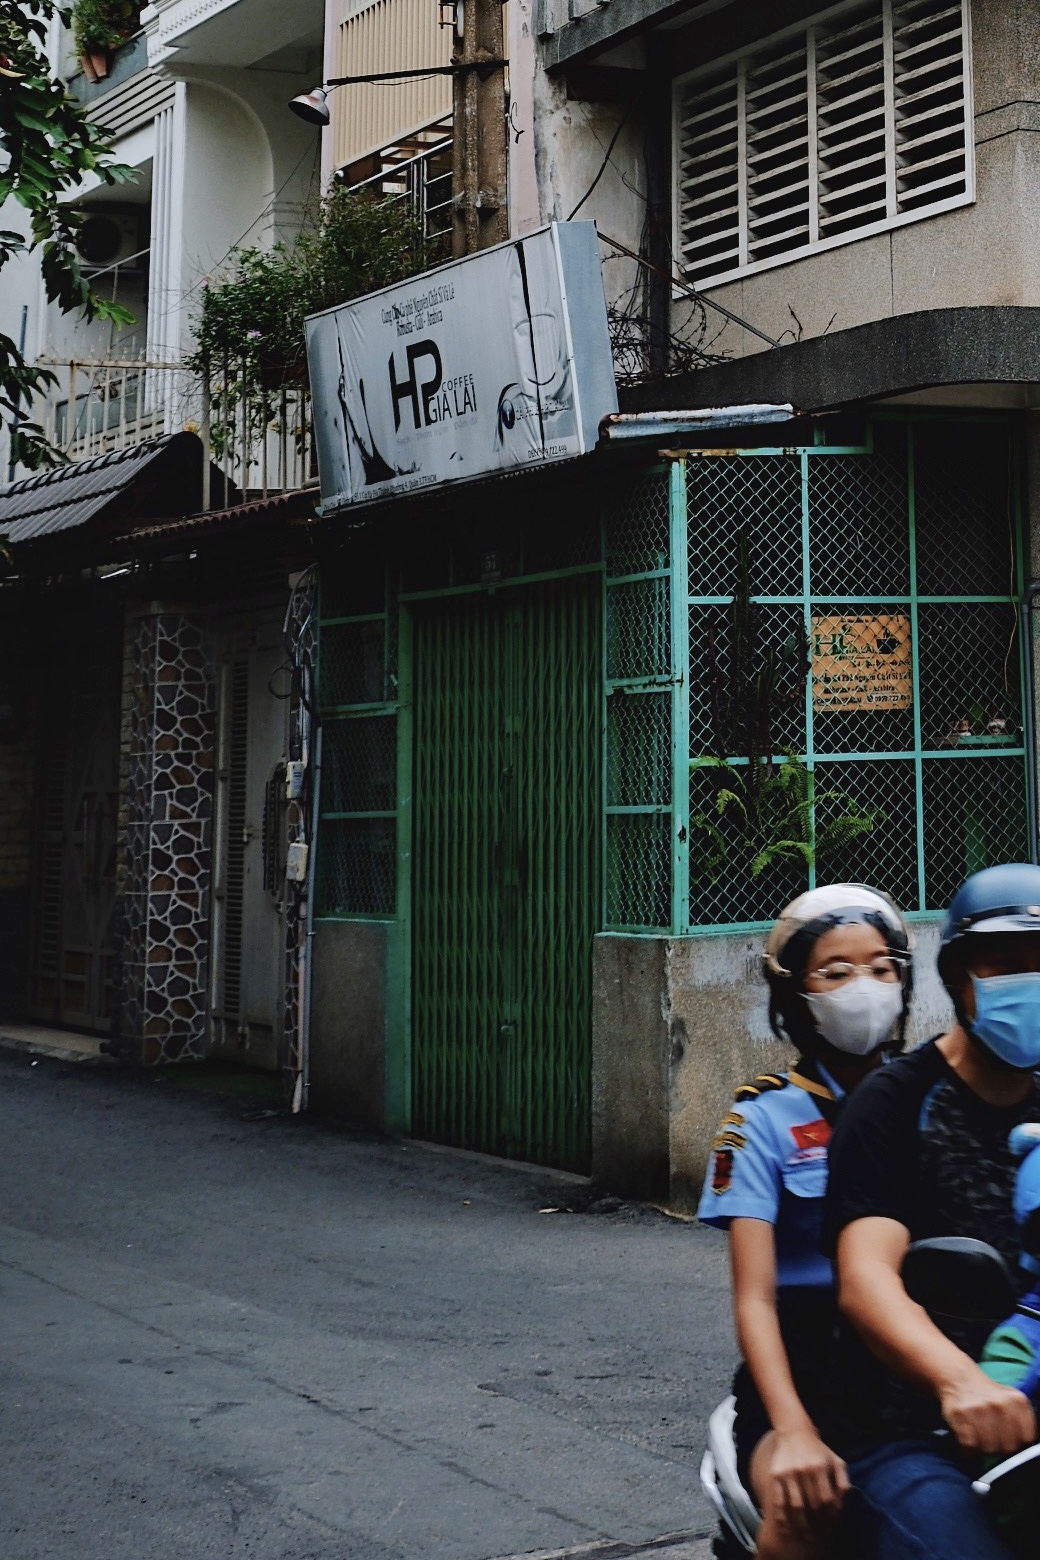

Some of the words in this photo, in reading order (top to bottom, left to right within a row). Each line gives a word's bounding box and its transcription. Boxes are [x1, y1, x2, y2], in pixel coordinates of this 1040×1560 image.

[388, 339, 442, 434] HP
[442, 373, 474, 393] COFFEE
[428, 393, 452, 424] GIA
[454, 385, 477, 416] LAI
